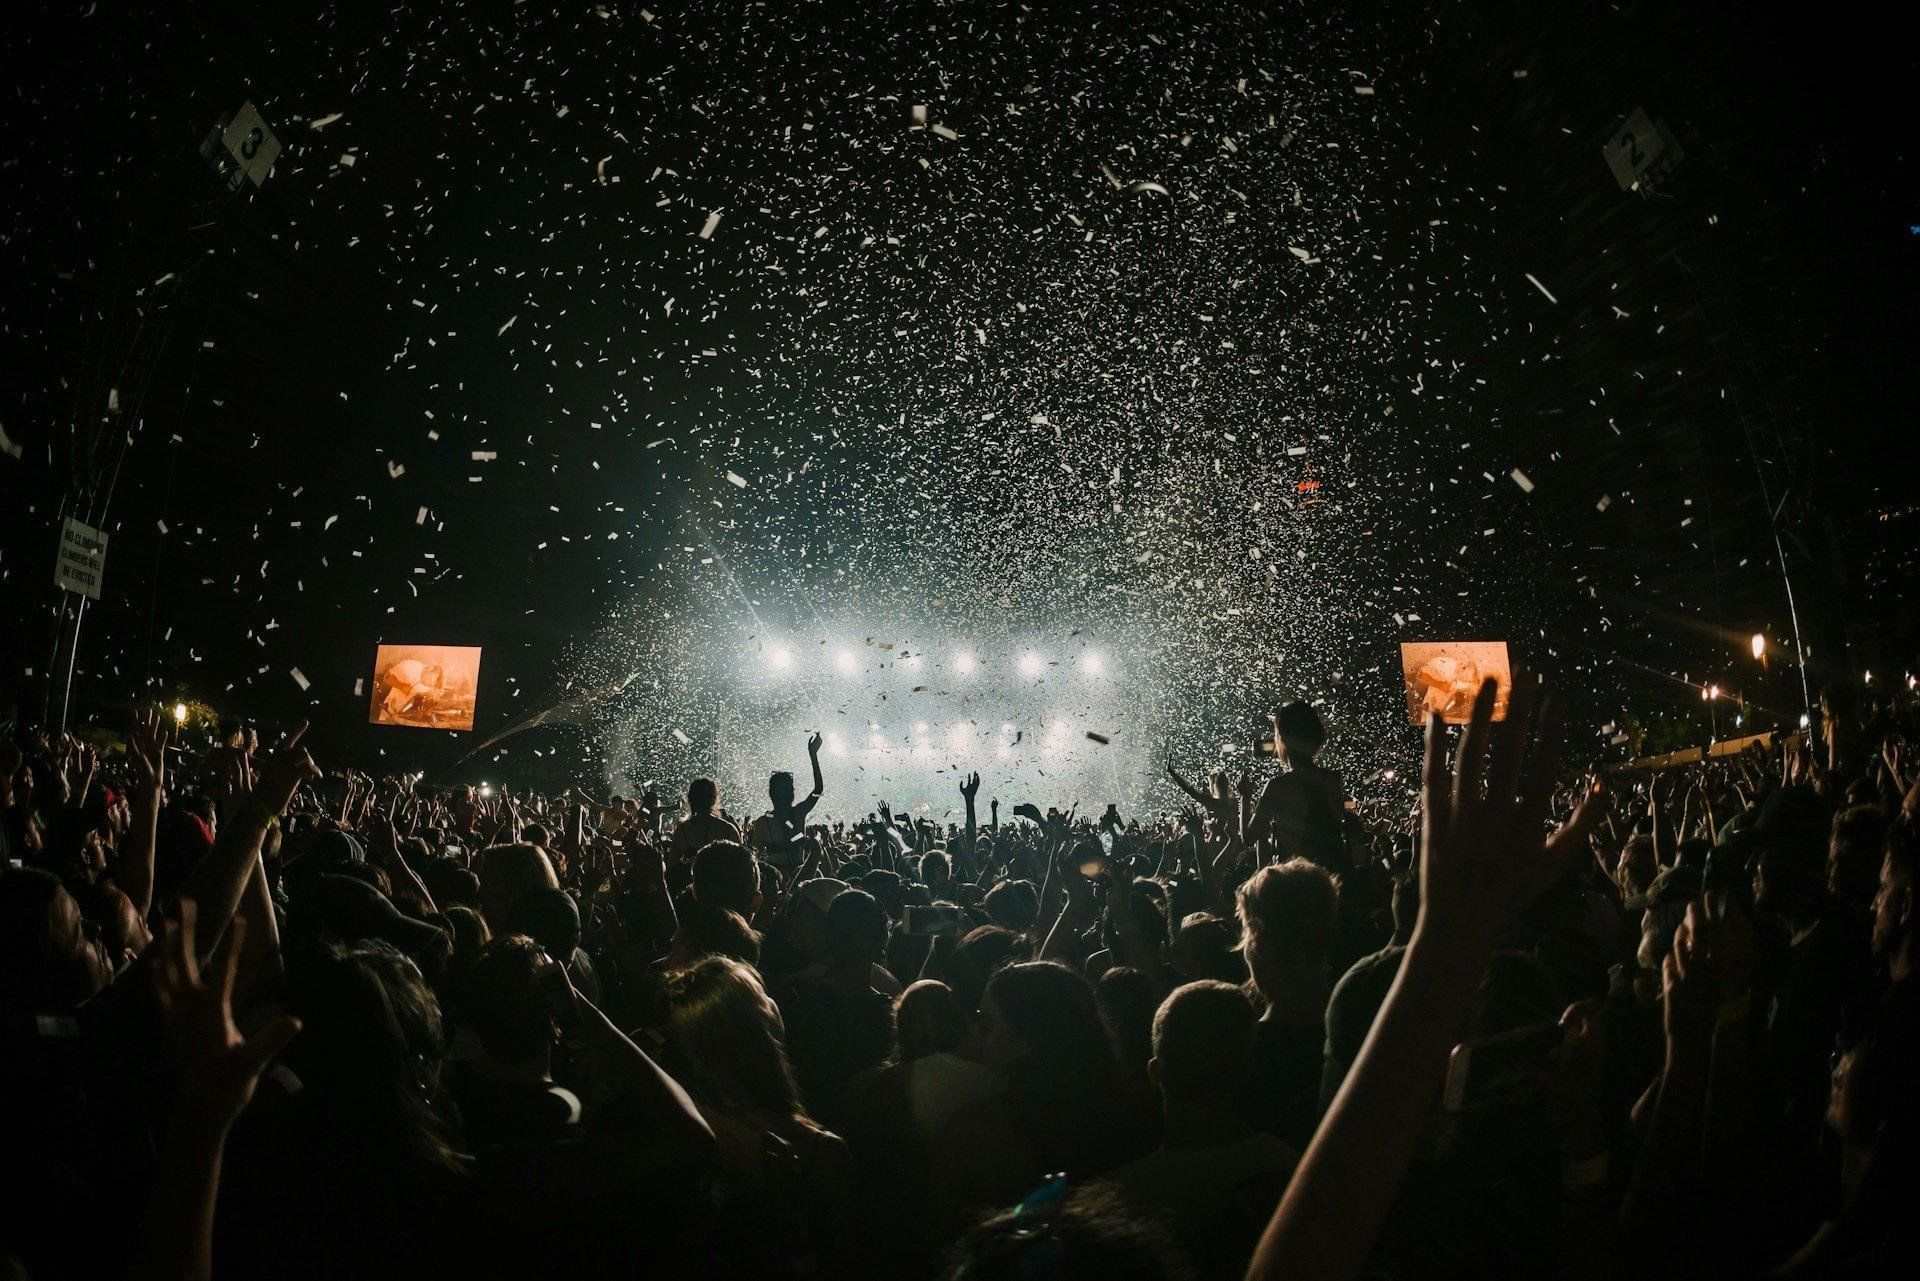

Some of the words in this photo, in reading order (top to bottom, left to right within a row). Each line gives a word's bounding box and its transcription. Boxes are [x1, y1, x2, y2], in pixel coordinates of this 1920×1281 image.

[241, 127, 263, 160] 3
[1621, 132, 1646, 168] 2
[65, 529, 74, 543] NO
[62, 547, 88, 566] CLIMBERS
[63, 565, 71, 577] BE
[71, 568, 96, 586] EVICTED
